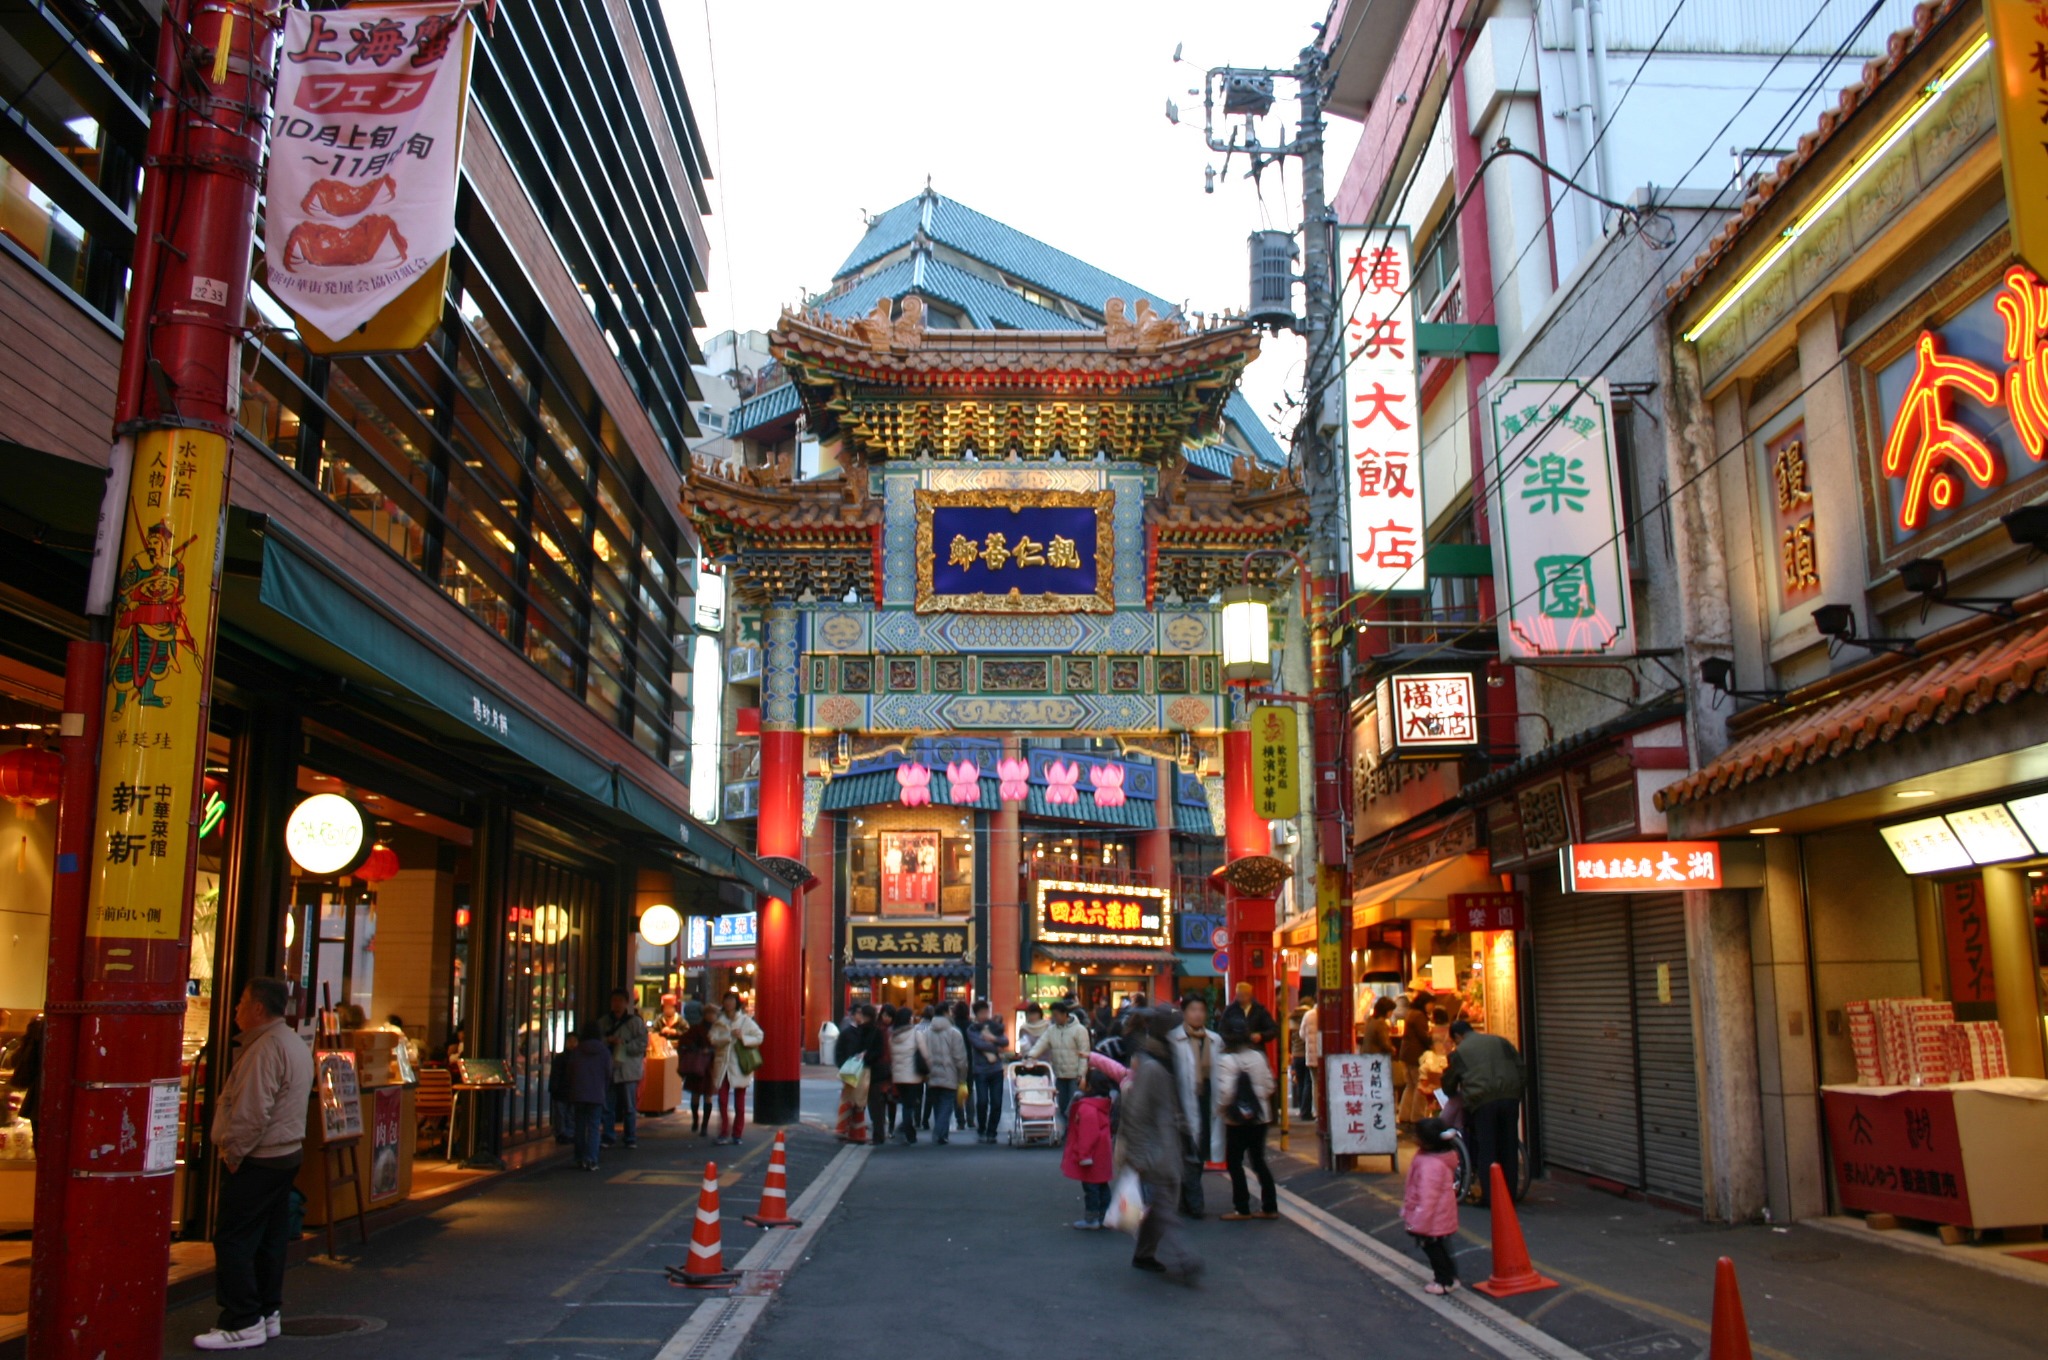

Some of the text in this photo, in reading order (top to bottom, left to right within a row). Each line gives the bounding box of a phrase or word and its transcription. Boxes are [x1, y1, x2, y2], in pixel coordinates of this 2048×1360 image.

[309, 80, 423, 109] フェア
[276, 115, 398, 150] 10月上旬
[1347, 246, 1417, 569] 横浜大飯店
[147, 451, 167, 509] 人物図
[172, 441, 197, 499] 水滸伝
[1520, 452, 1597, 619] 楽園
[106, 781, 151, 867] 新新
[149, 784, 172, 858] 中華菜館
[1655, 851, 1715, 881] 太湖
[857, 931, 963, 954] 四五六菜館
[1050, 899, 1143, 930] 四五六菜館
[1955, 882, 1984, 1000] シウマイ
[1370, 1060, 1386, 1130] 店前につき
